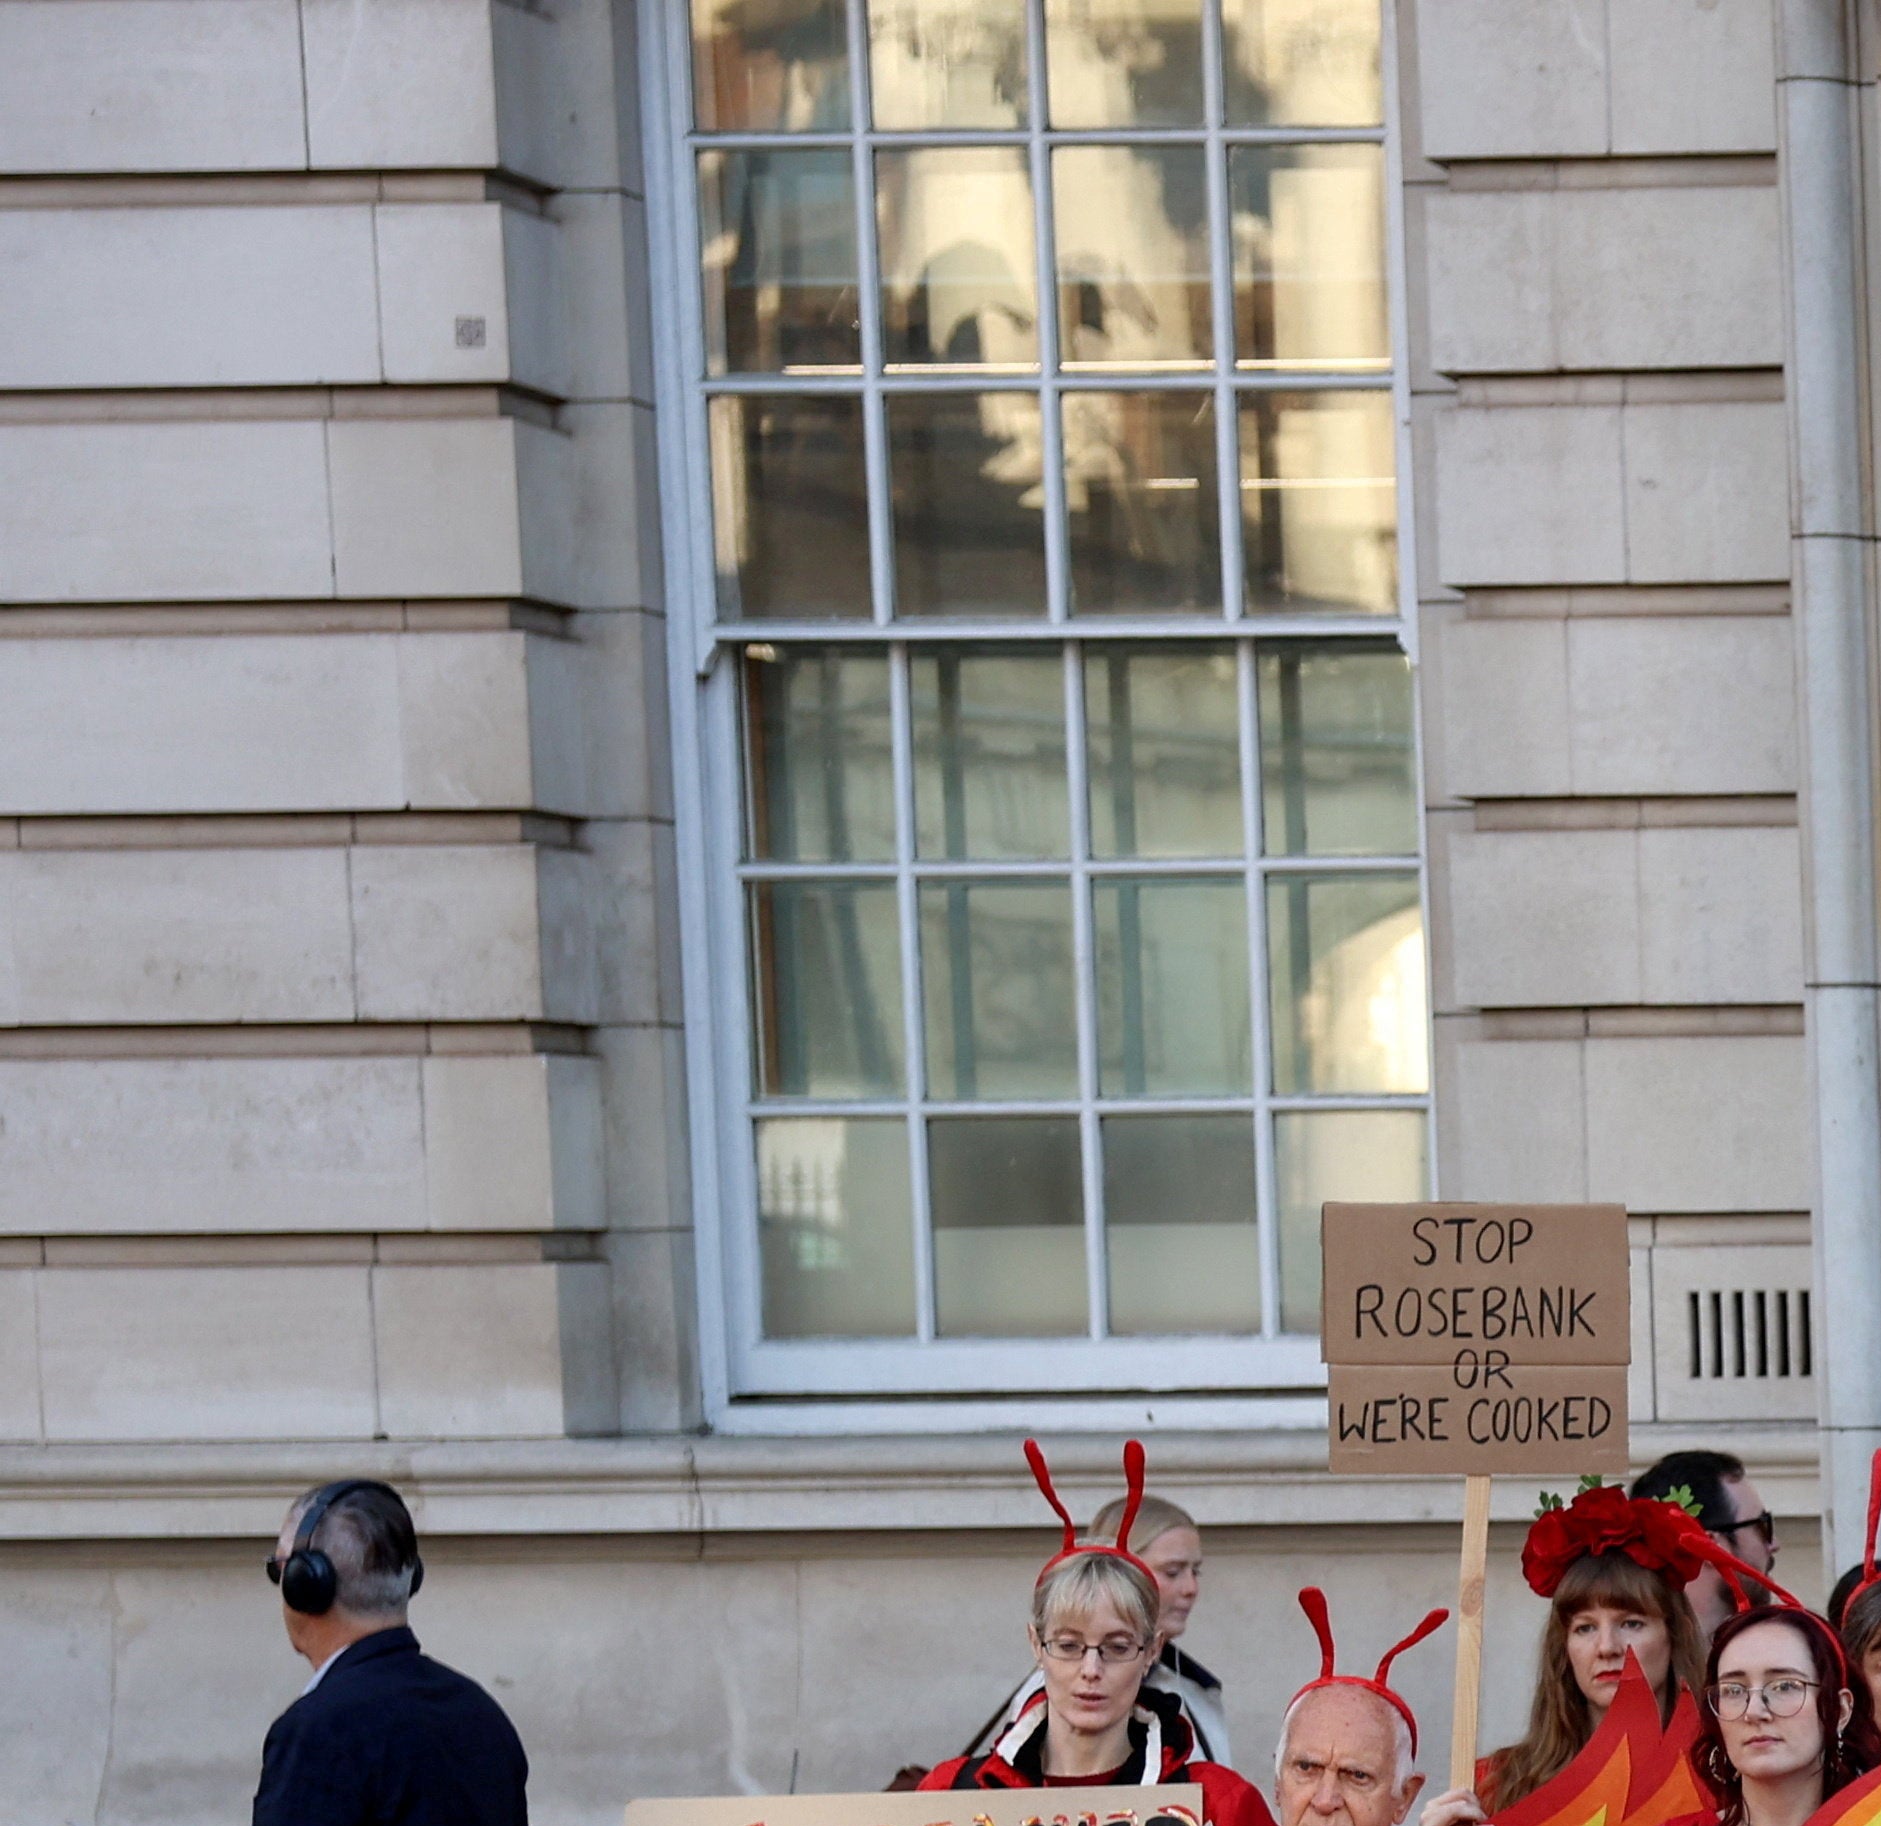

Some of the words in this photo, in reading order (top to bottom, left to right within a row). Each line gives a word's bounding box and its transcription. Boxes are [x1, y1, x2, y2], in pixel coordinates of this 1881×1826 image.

[1413, 1217, 1534, 1266] STOP
[1355, 1284, 1597, 1340] ROSEBANK
[1453, 1349, 1514, 1390] OR
[1338, 1393, 1450, 1443] WE'RE
[1466, 1396, 1612, 1445] COOKED
